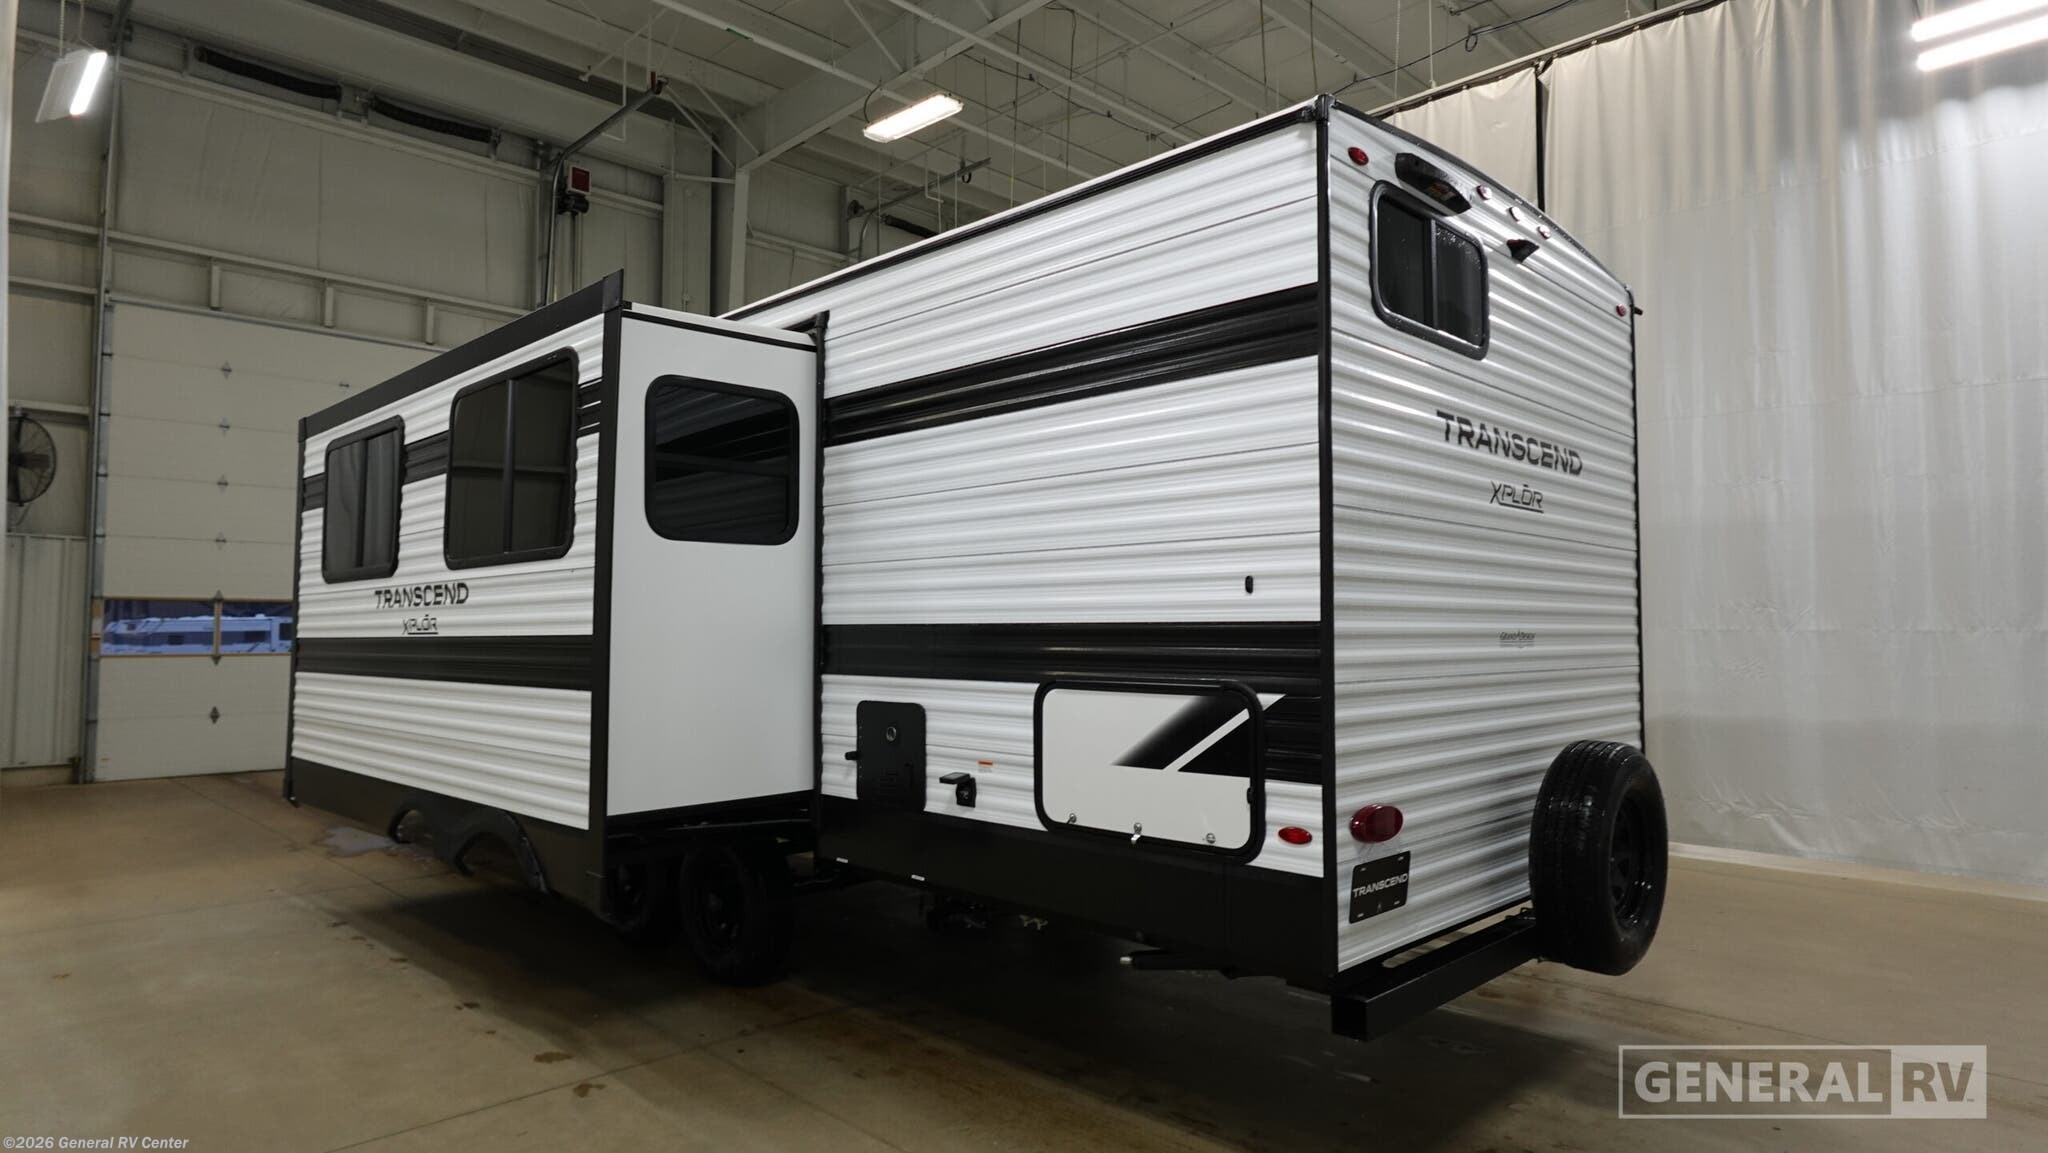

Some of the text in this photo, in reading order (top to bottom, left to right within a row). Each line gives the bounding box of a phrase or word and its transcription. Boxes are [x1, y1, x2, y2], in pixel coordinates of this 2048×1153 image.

[1436, 409, 1583, 476] TRANSCEND
[374, 582, 469, 609] TRANSCEND
[1352, 873, 1408, 898] TRANSCEND
